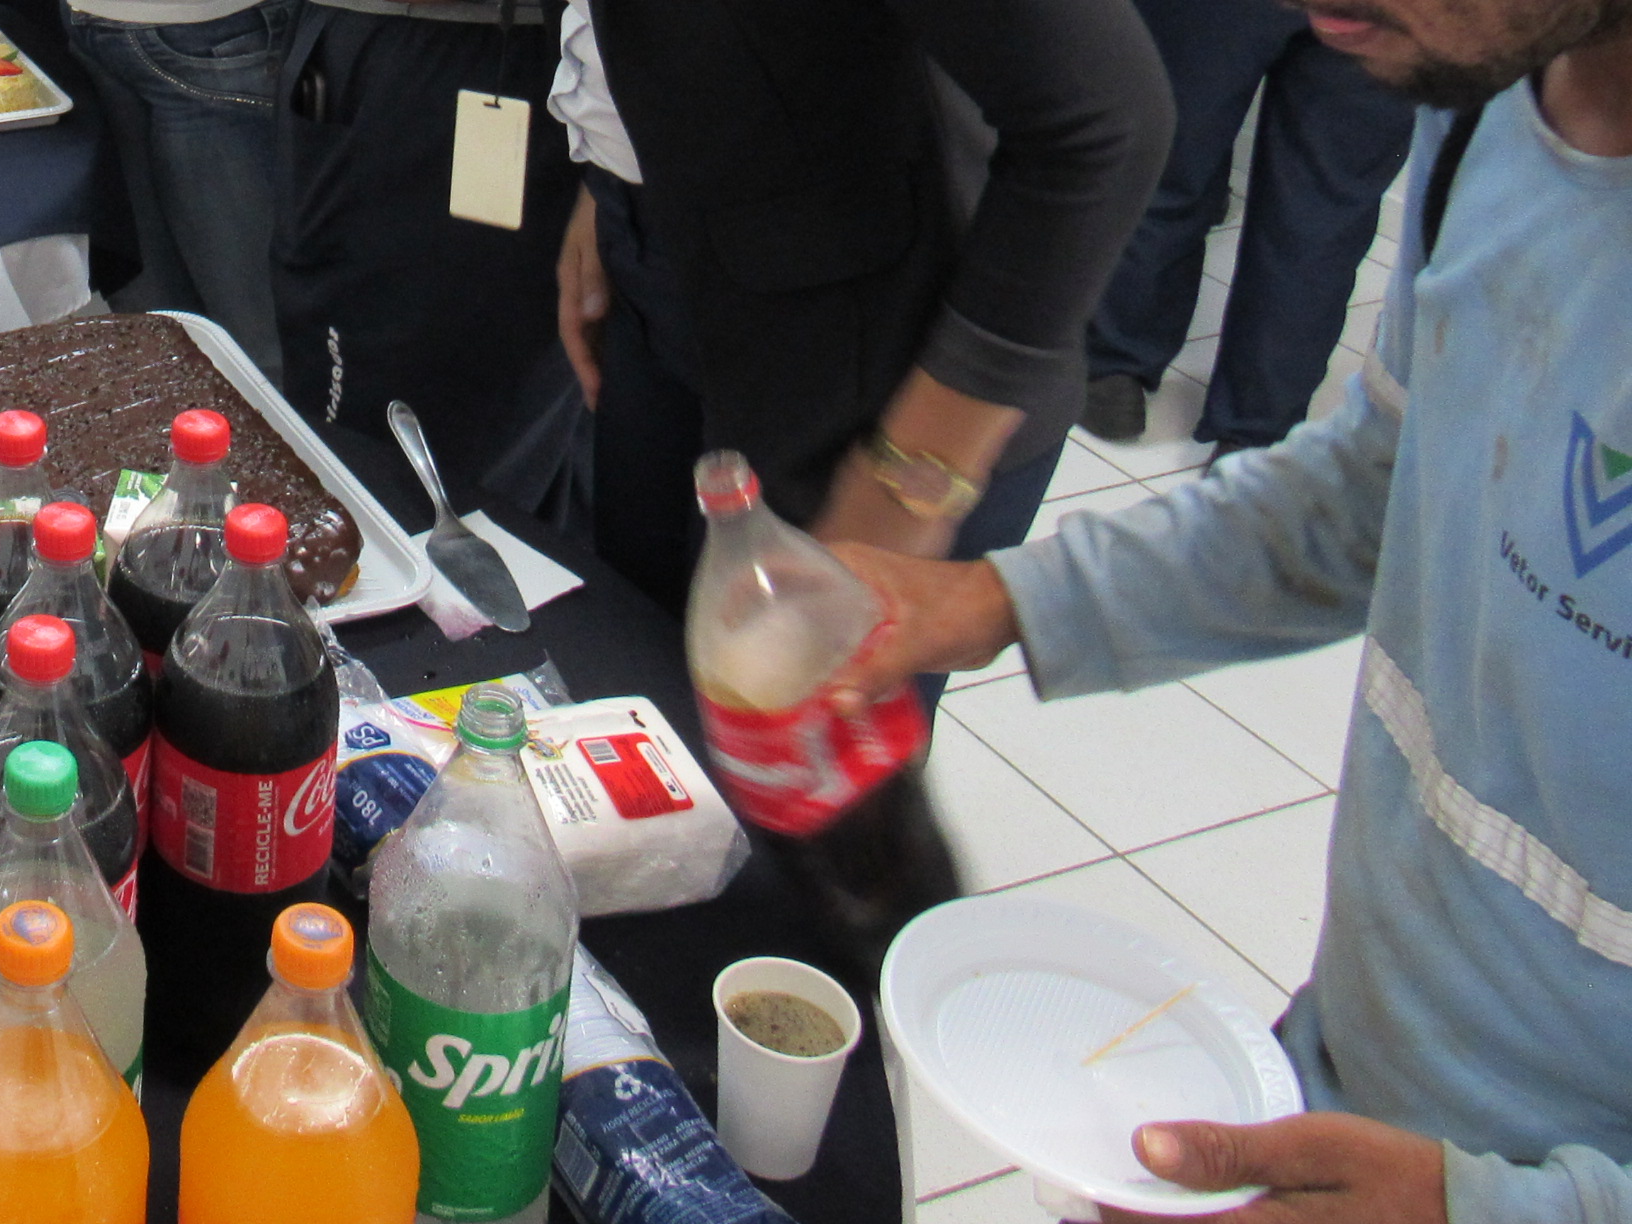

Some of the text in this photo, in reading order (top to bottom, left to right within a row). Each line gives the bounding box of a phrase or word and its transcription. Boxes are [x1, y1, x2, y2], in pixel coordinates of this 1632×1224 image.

[1500, 530, 1550, 602] Vetor
[352, 724, 383, 747] PS
[254, 779, 274, 886] RECICLE-ME
[352, 789, 383, 826] 180
